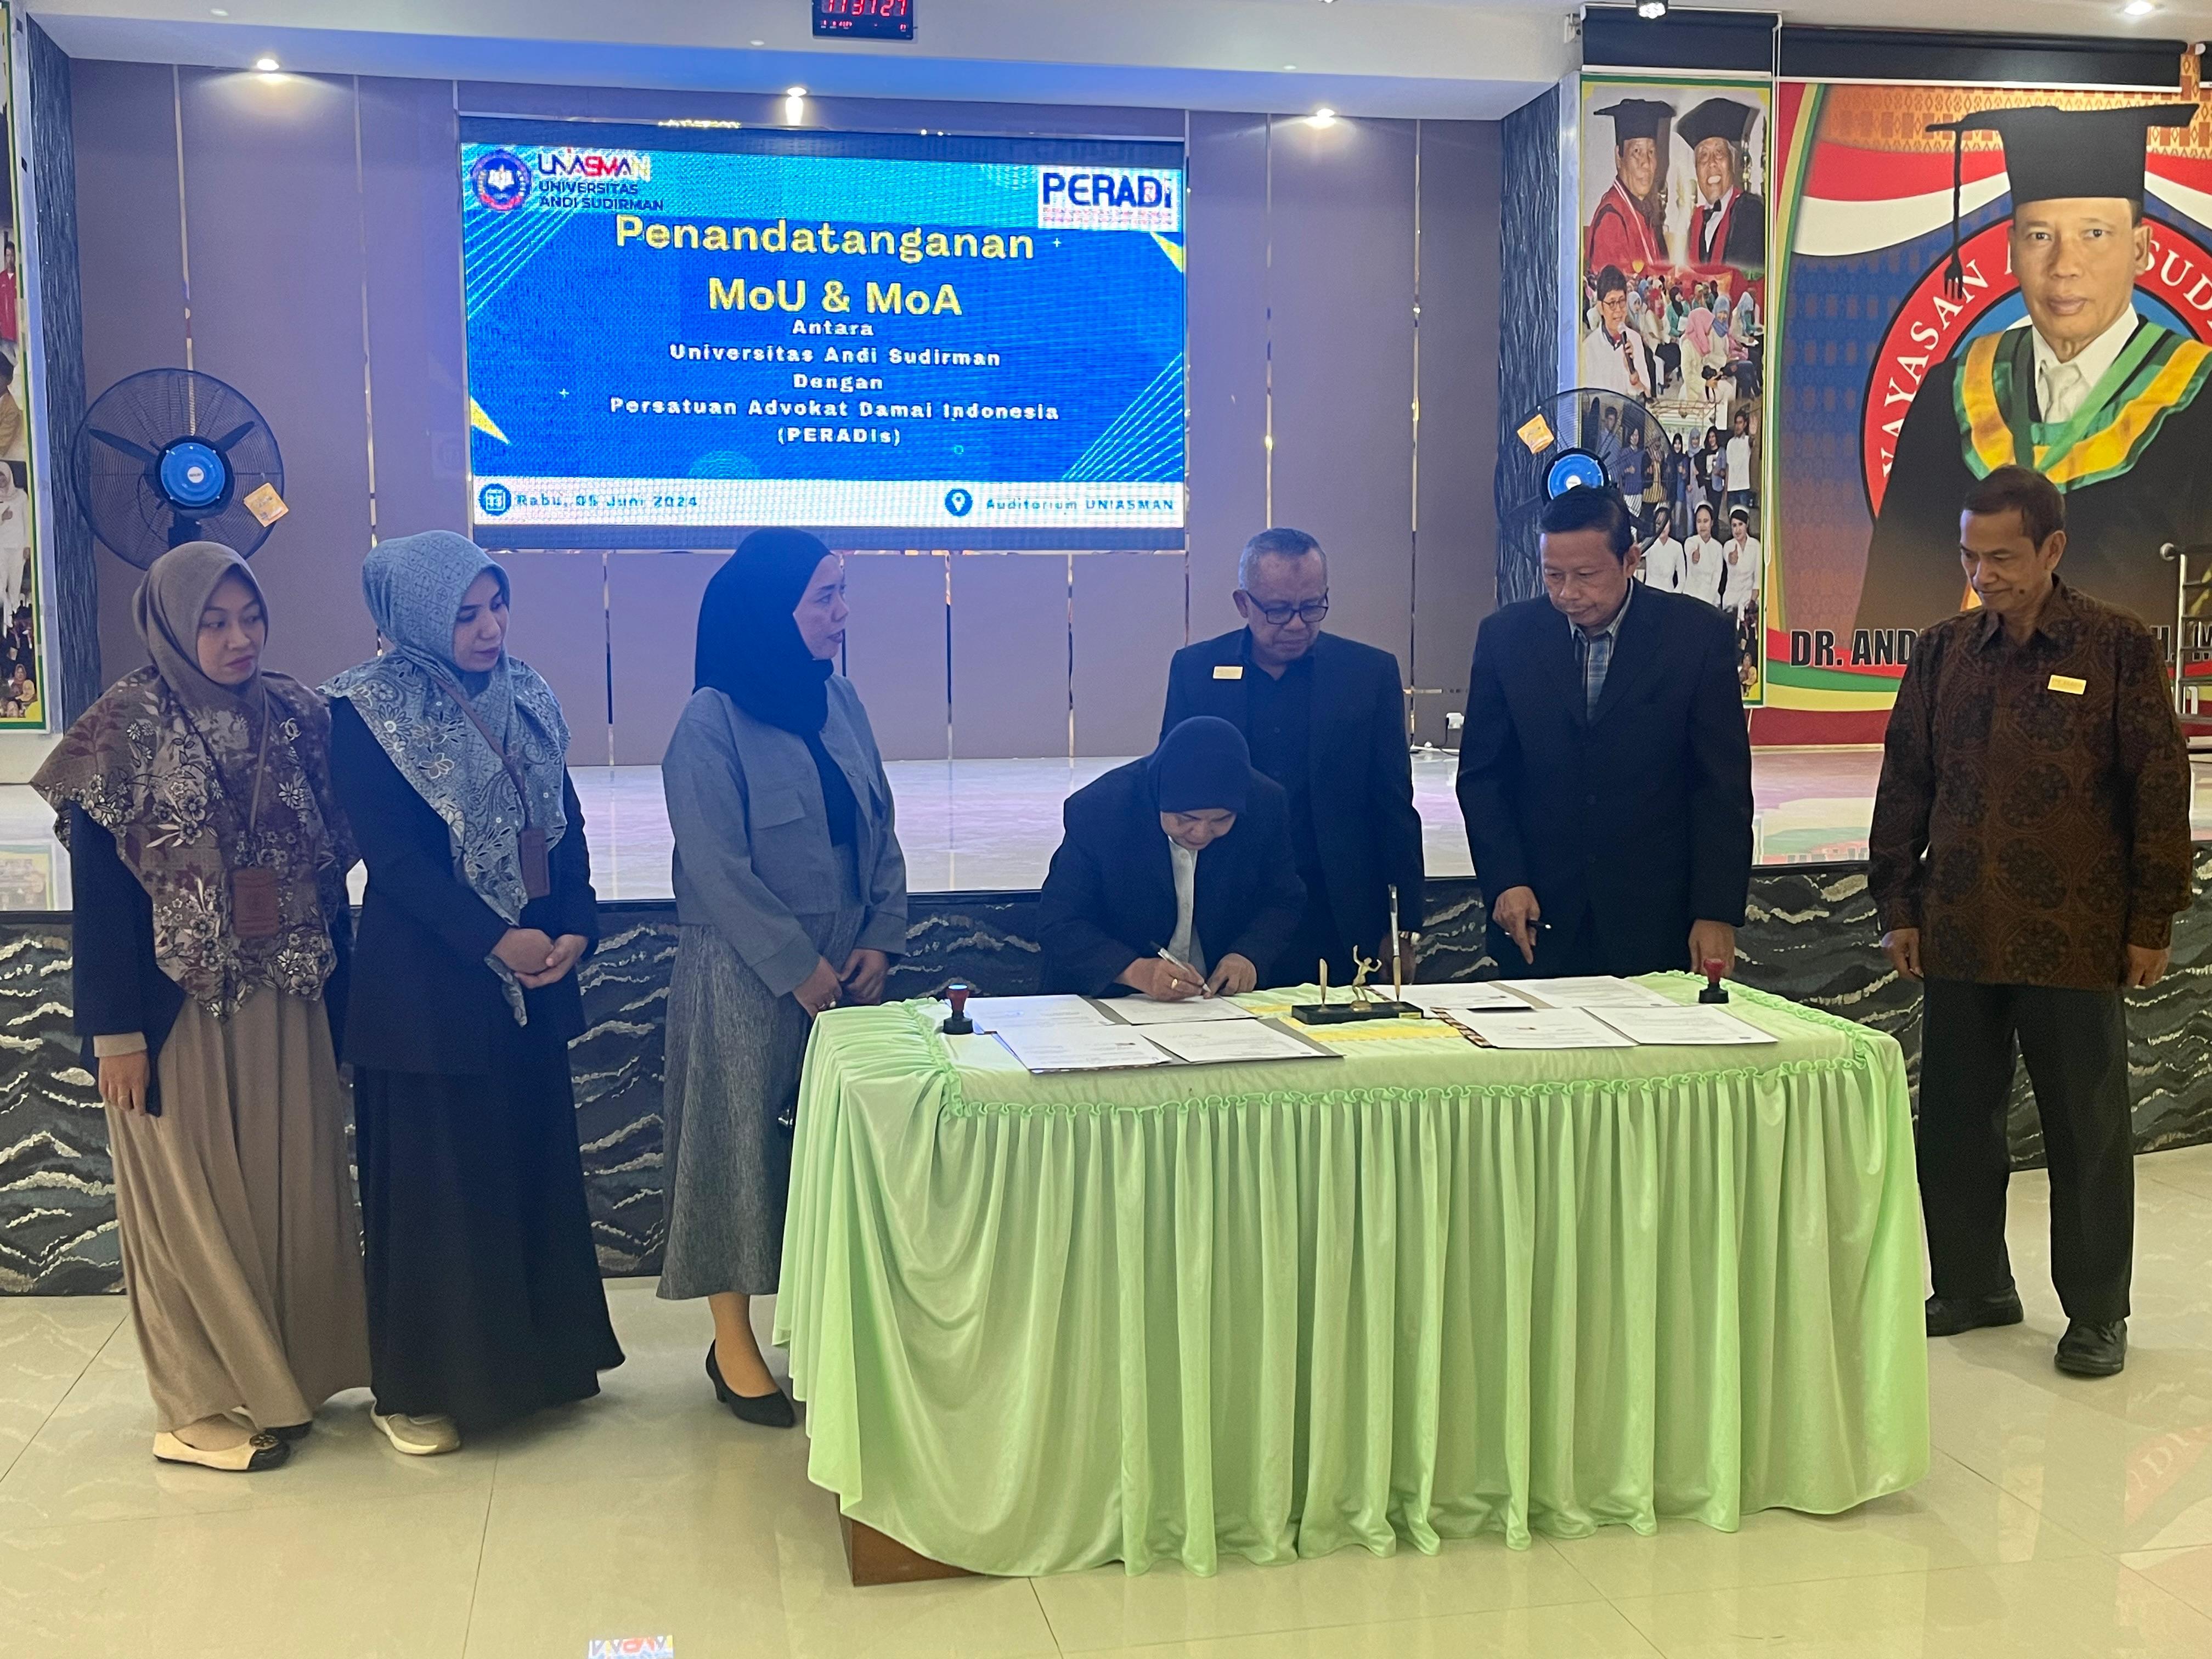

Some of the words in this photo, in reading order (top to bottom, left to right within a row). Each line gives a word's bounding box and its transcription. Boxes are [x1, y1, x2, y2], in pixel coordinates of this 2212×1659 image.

[539, 181, 638, 194] UNIVERSITAS
[541, 197, 577, 208] ANDI
[583, 199, 664, 211] SUDIRMAN
[617, 215, 1034, 263] Penandatanganan
[709, 278, 805, 312] MoU
[822, 280, 850, 313] &
[867, 282, 962, 315] MoA
[792, 320, 874, 336] Antara
[670, 345, 813, 362] Universitas
[824, 347, 877, 363] Andi
[889, 348, 1000, 366] Sudirman
[793, 374, 883, 393] Dengan
[611, 397, 736, 415] Persatuan
[748, 400, 848, 416] Advokat
[860, 402, 932, 418] Damai
[944, 403, 1059, 421] Indonesia
[778, 427, 900, 447] (PERADIs)
[607, 495, 644, 507] Juni
[654, 496, 697, 507] 2024
[986, 498, 1077, 510] Auditorium
[1086, 499, 1173, 510] UNIASMAN
[1790, 629, 1844, 667] DR.
[1850, 629, 1925, 667] AND
